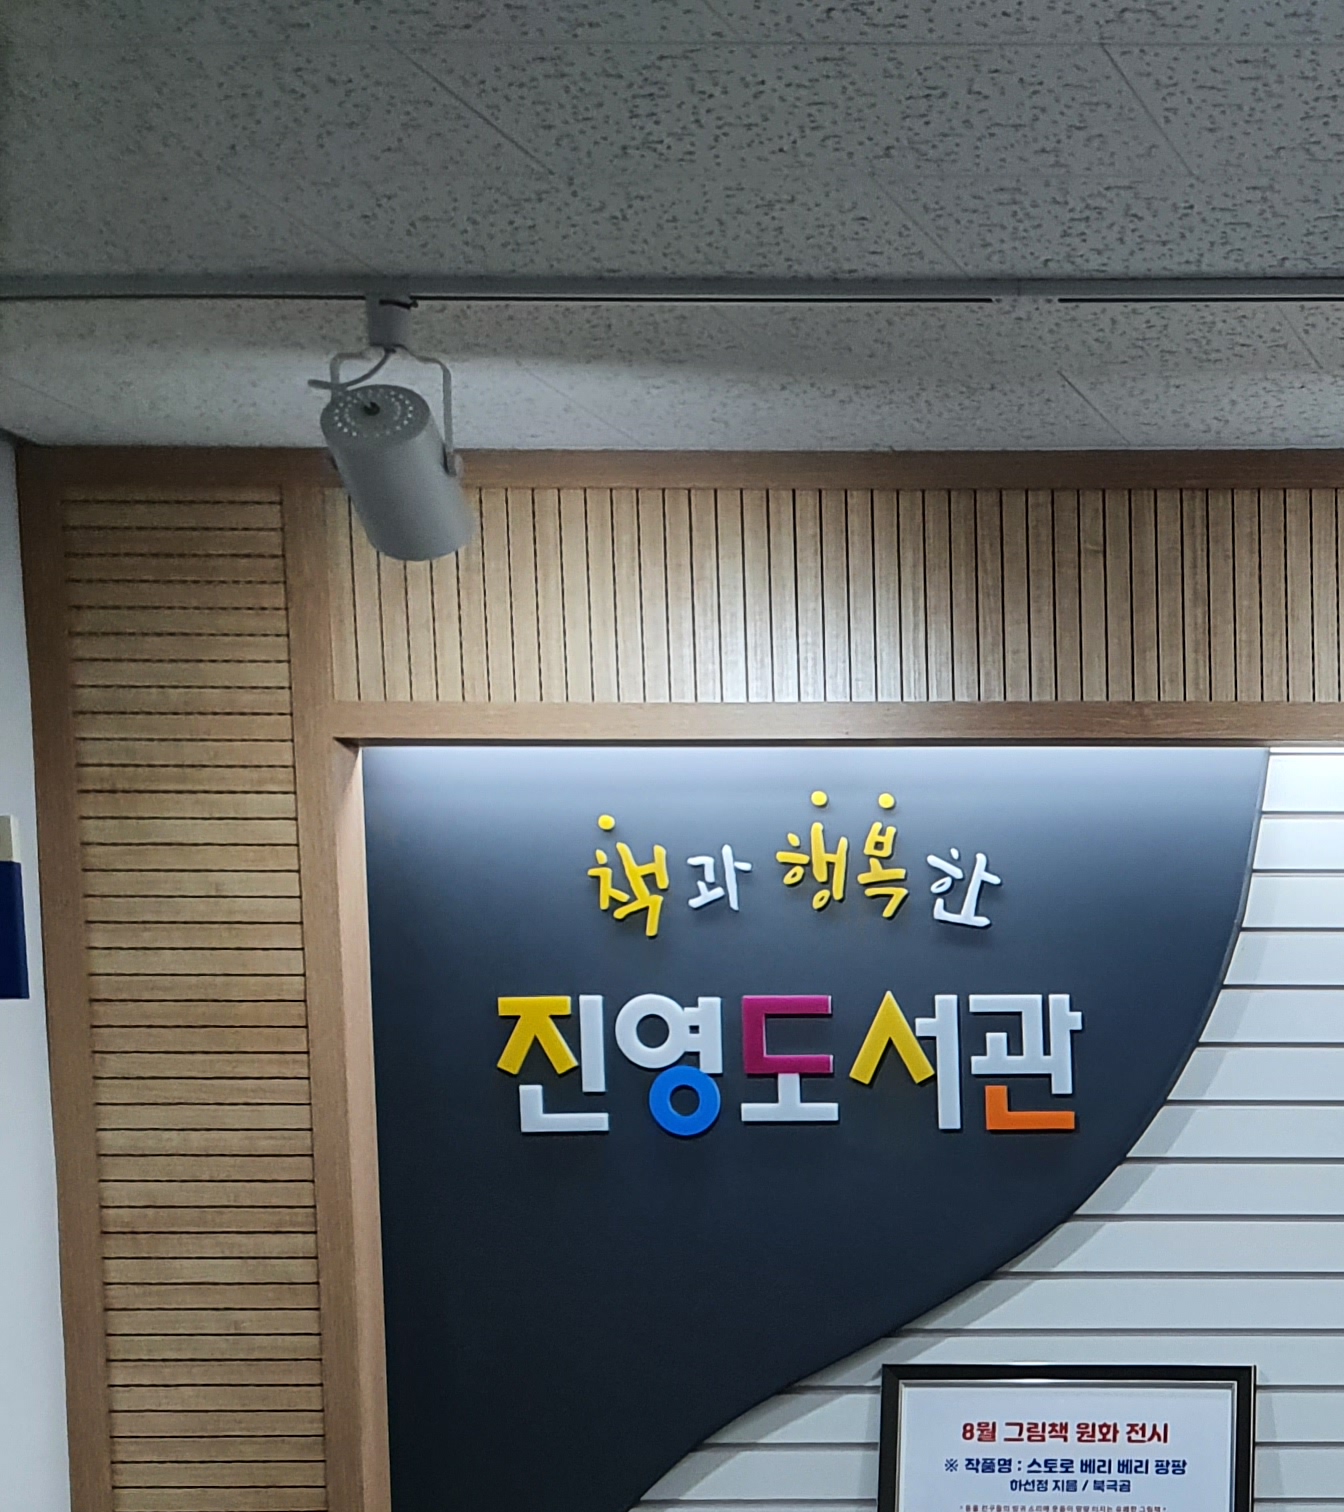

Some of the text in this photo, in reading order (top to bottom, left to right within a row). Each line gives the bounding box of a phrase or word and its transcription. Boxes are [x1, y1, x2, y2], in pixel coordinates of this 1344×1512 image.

[587, 790, 1001, 937] 책과 행복한
[496, 990, 1083, 1137] 진영도서관
[961, 1421, 1168, 1444] 8월 그림책 원화 전시
[964, 1457, 1012, 1474] 작품명
[1080, 1458, 1112, 1475] 베리
[1117, 1458, 1149, 1475] 베리
[1154, 1459, 1188, 1475] 팡팡
